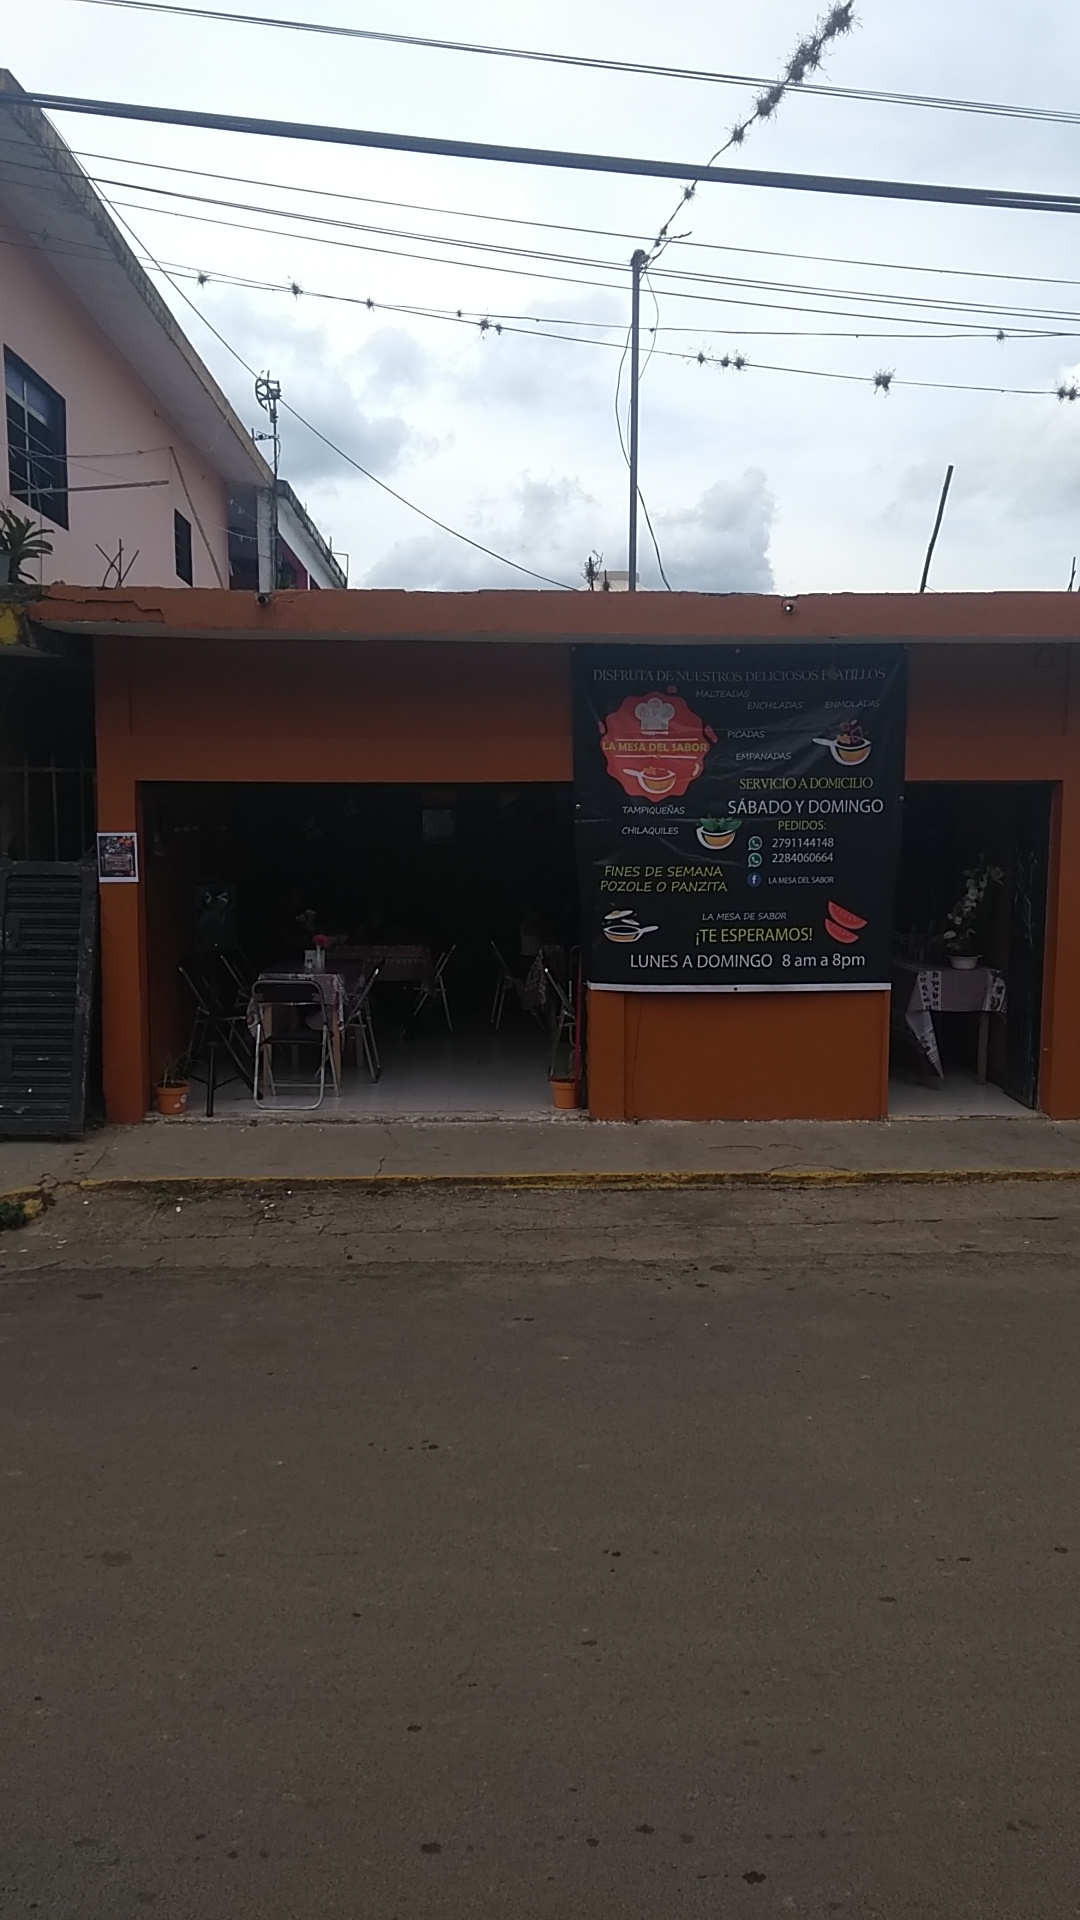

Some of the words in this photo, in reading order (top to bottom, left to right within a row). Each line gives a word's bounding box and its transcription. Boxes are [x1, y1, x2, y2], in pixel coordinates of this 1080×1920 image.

[593, 669, 653, 682] DISFRUTA
[656, 670, 674, 681] DE
[676, 670, 742, 682] NUESTROS
[745, 669, 818, 681] DELICIOSOS
[822, 668, 886, 681] PATILLOS
[696, 689, 749, 698] MALTEADAS
[747, 701, 803, 710] ENCHILADAS
[825, 699, 880, 709] ENMOLADAS
[727, 730, 765, 739] PICADAS
[602, 741, 616, 752] LA
[618, 741, 648, 752] MESA
[649, 741, 669, 752] DEL
[671, 742, 708, 753] SABOR
[735, 752, 792, 761] EMPANADAS
[739, 777, 796, 790] SERVICIO
[798, 777, 808, 789] A
[809, 777, 873, 789] DOMICILIO
[622, 804, 685, 816] TAMPIQUEÑAS
[728, 797, 791, 814] SÁBADO
[795, 800, 804, 814] Y
[808, 798, 884, 814] DOMINGO
[778, 820, 826, 831] PEDIDOS:
[621, 826, 679, 836] CHILAQUILES
[772, 838, 834, 848] 2791144148
[771, 853, 834, 863] 2284060664
[605, 865, 640, 877] FINES
[645, 867, 663, 877] DE
[667, 866, 722, 877] SEMANA
[768, 876, 776, 885] LA
[778, 876, 797, 885] MESA
[798, 876, 811, 885] DEL
[811, 876, 834, 885] SABOR
[600, 880, 652, 892] POZOLE
[656, 881, 667, 892] O
[671, 881, 727, 892] PANZITA
[717, 912, 741, 920] MESA
[743, 912, 755, 920] DE
[758, 912, 787, 920] SABOR
[695, 929, 717, 946] ¡TE
[721, 928, 813, 942] ESPERAMOS!
[630, 954, 678, 968] LUNES
[682, 955, 693, 968] A
[697, 953, 773, 968] DOMINGO
[782, 953, 791, 967] 8
[794, 957, 817, 967] am
[820, 957, 829, 967] a
[833, 954, 866, 970] 8pm
